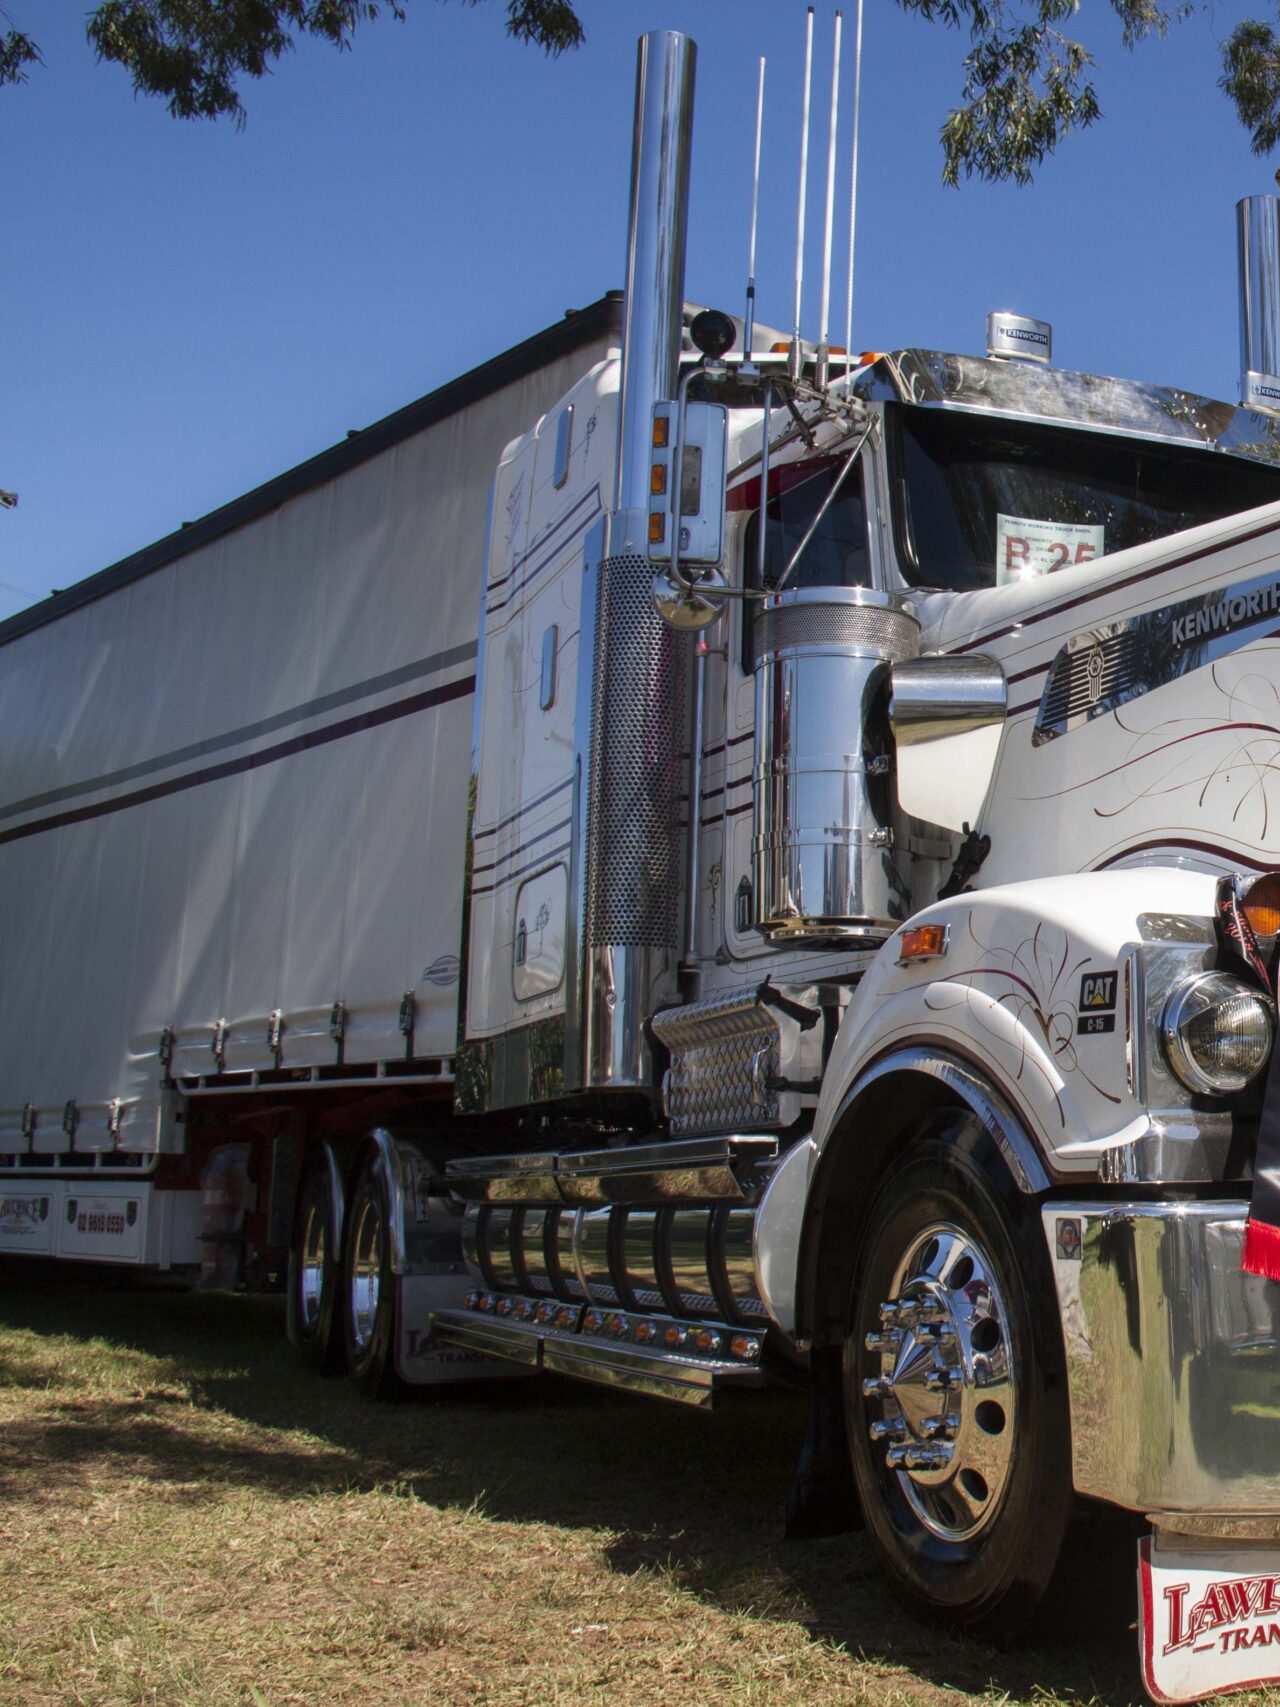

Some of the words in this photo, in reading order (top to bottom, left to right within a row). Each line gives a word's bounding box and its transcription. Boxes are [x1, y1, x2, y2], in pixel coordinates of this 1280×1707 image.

[1007, 329, 1048, 344] KENWORTH
[1083, 978, 1113, 1006] CAT
[1087, 1018, 1105, 1031] C-15
